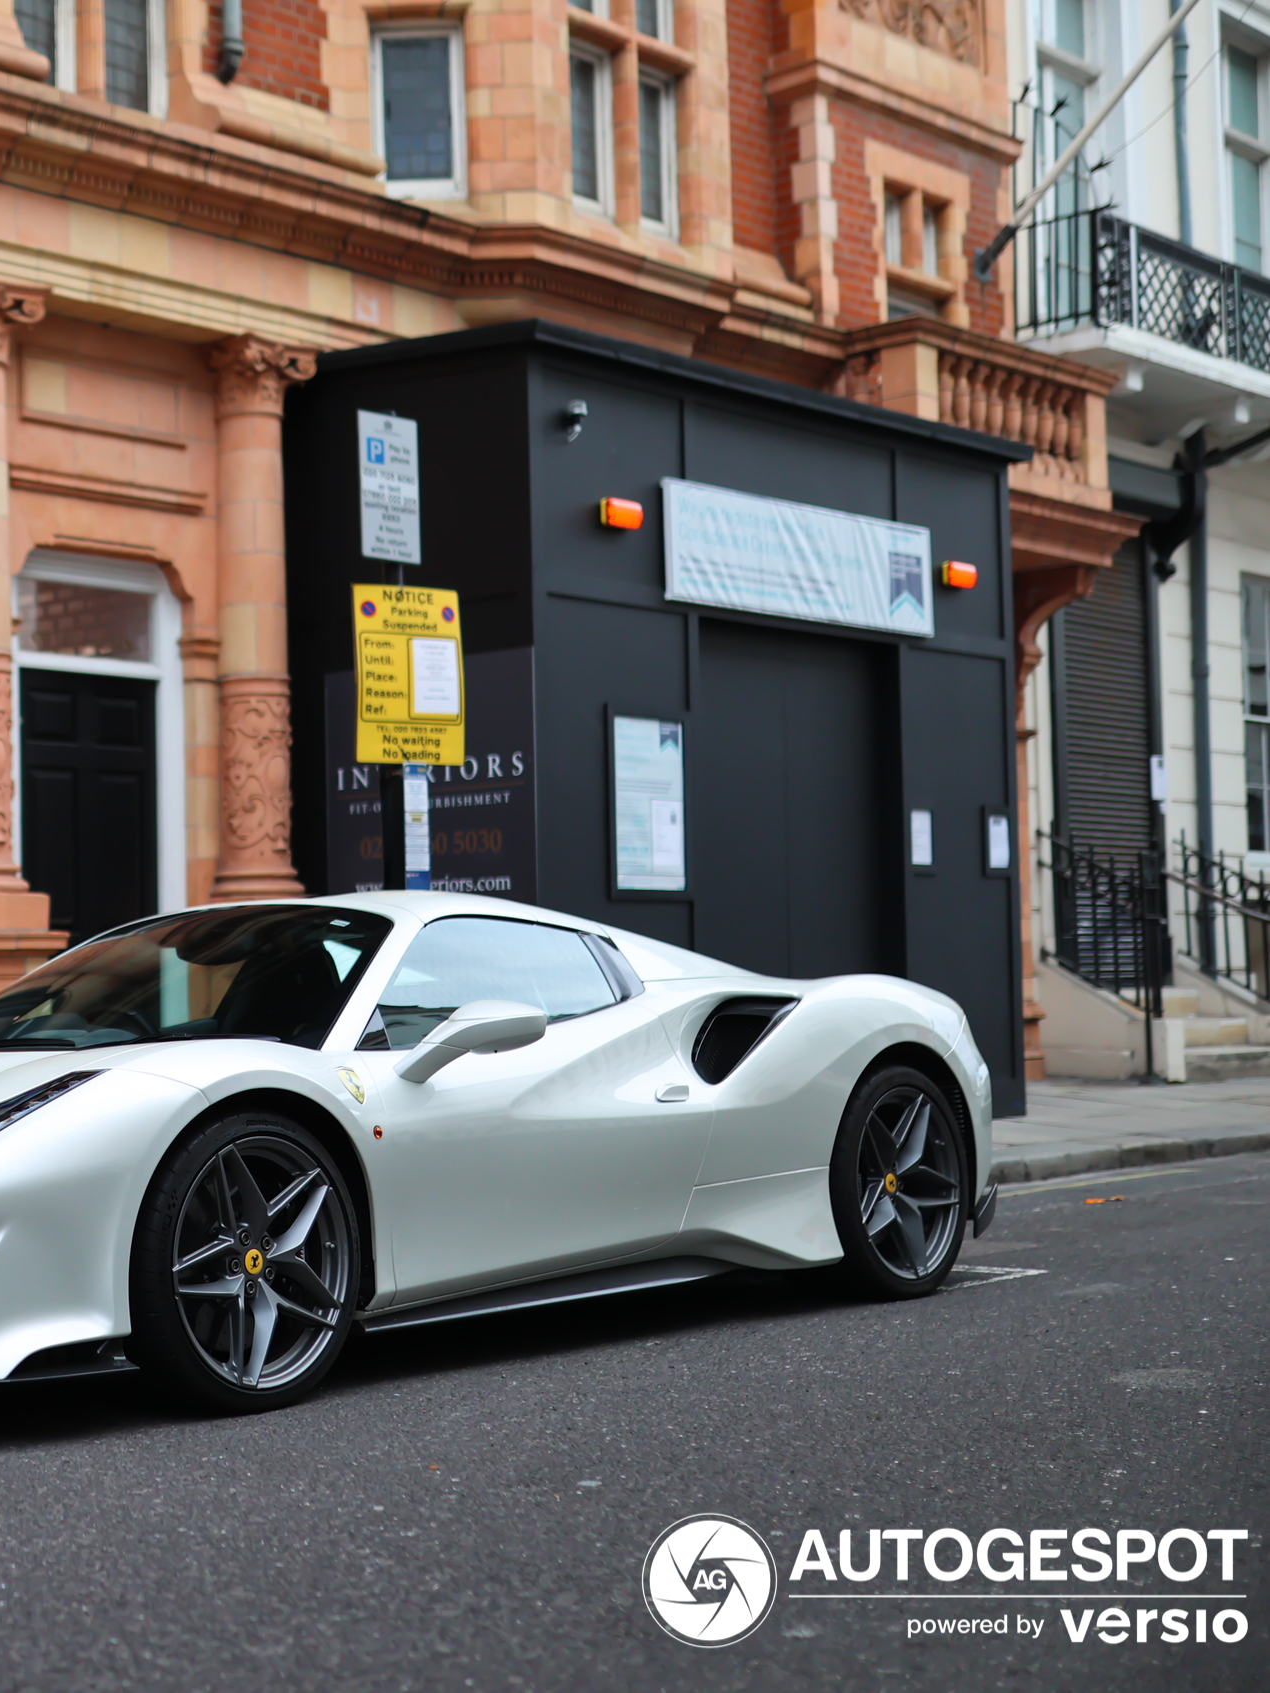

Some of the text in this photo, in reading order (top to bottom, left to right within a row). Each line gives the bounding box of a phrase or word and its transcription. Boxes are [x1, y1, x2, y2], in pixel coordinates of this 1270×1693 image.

[382, 589, 434, 605] NOTICE
[391, 607, 428, 619] Parking
[383, 620, 438, 632] Suspended
[365, 639, 395, 650] From:
[365, 655, 395, 666] Until:
[365, 671, 397, 683] Place:
[365, 688, 408, 700] Reason:
[365, 704, 387, 715] Ref:
[382, 734, 441, 748] No waiting
[382, 748, 398, 759] No
[454, 829, 503, 855] 5030
